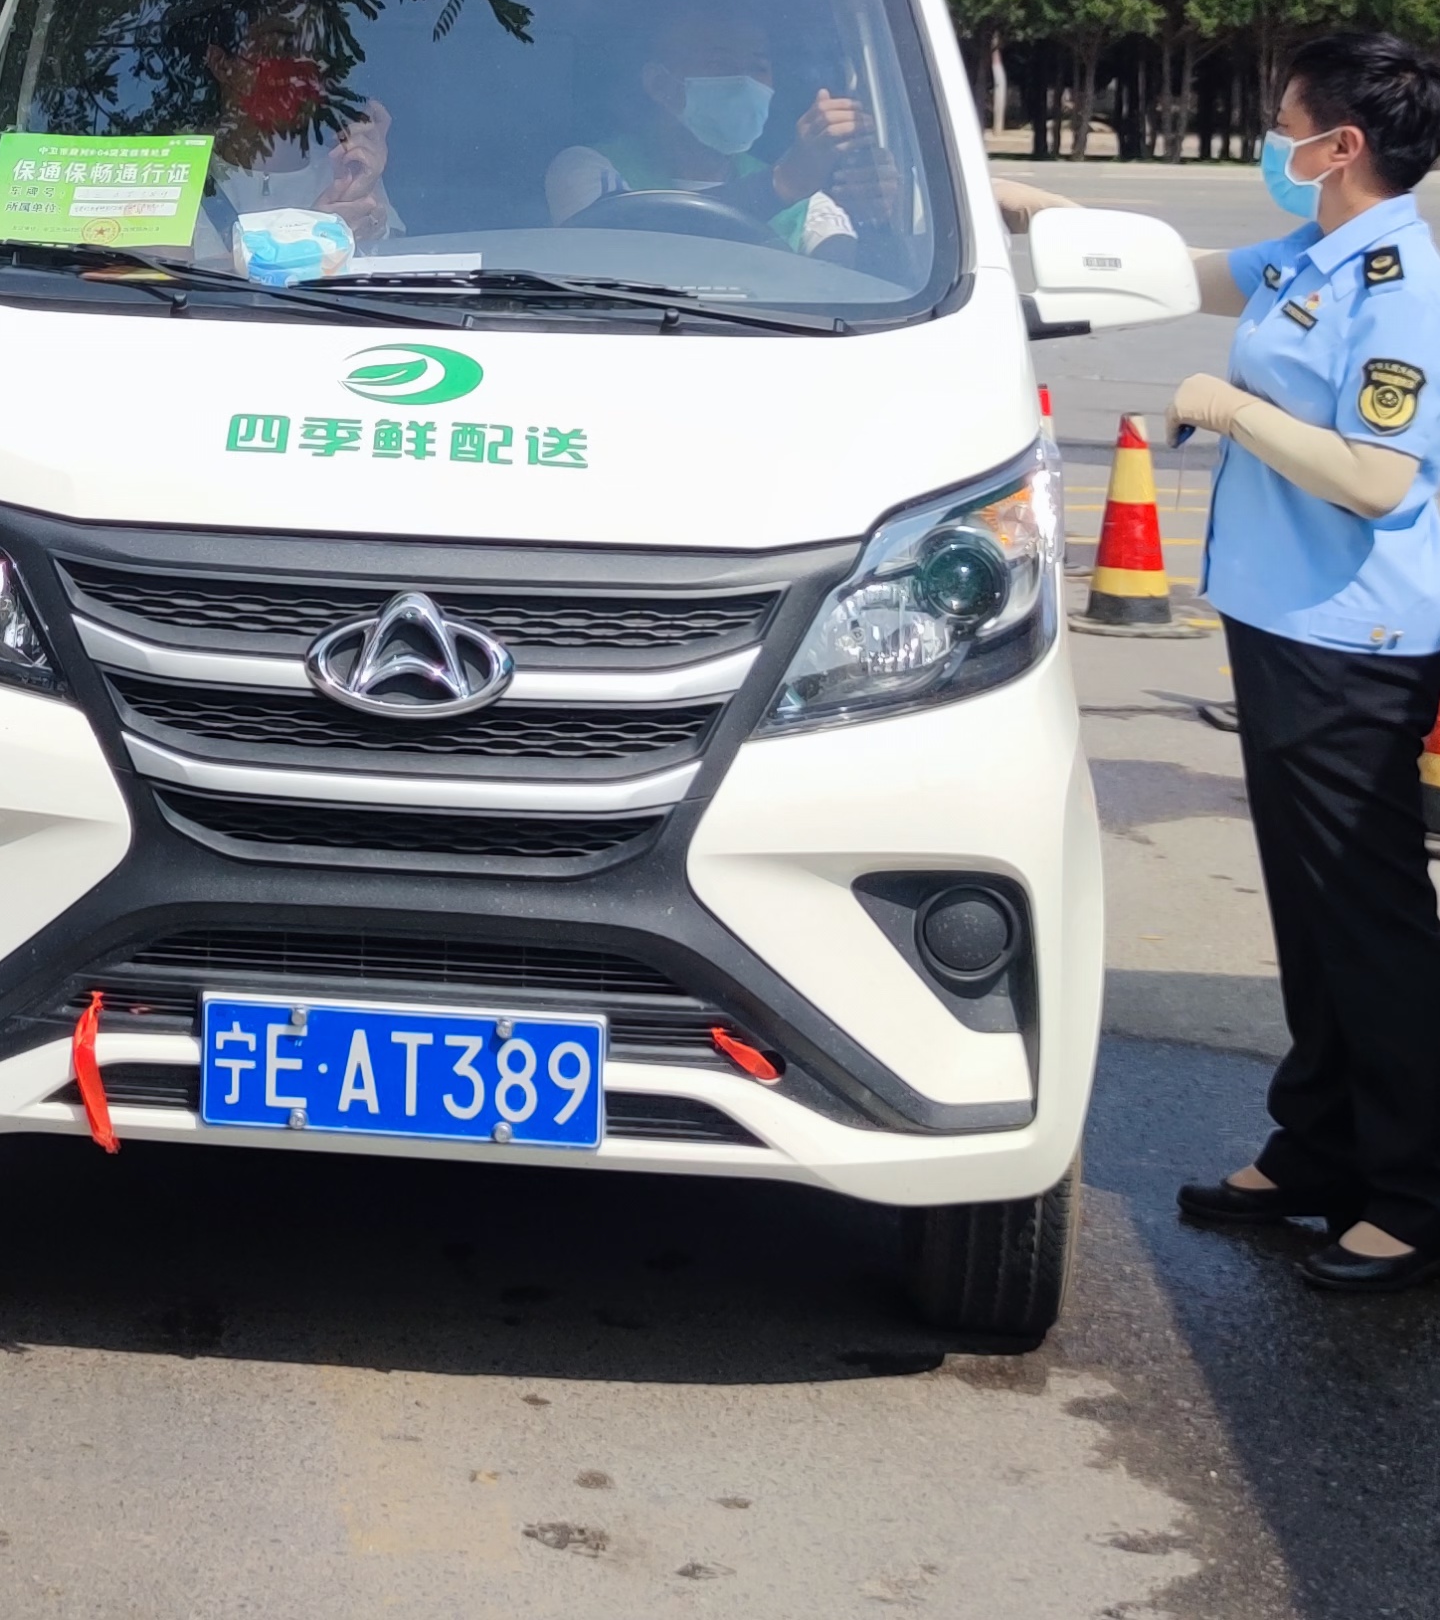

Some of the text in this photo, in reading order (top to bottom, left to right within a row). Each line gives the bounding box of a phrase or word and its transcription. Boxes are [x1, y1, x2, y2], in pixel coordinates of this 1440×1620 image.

[12, 158, 191, 184] 保通保畅通行证
[225, 413, 588, 469] 四季鲜配送
